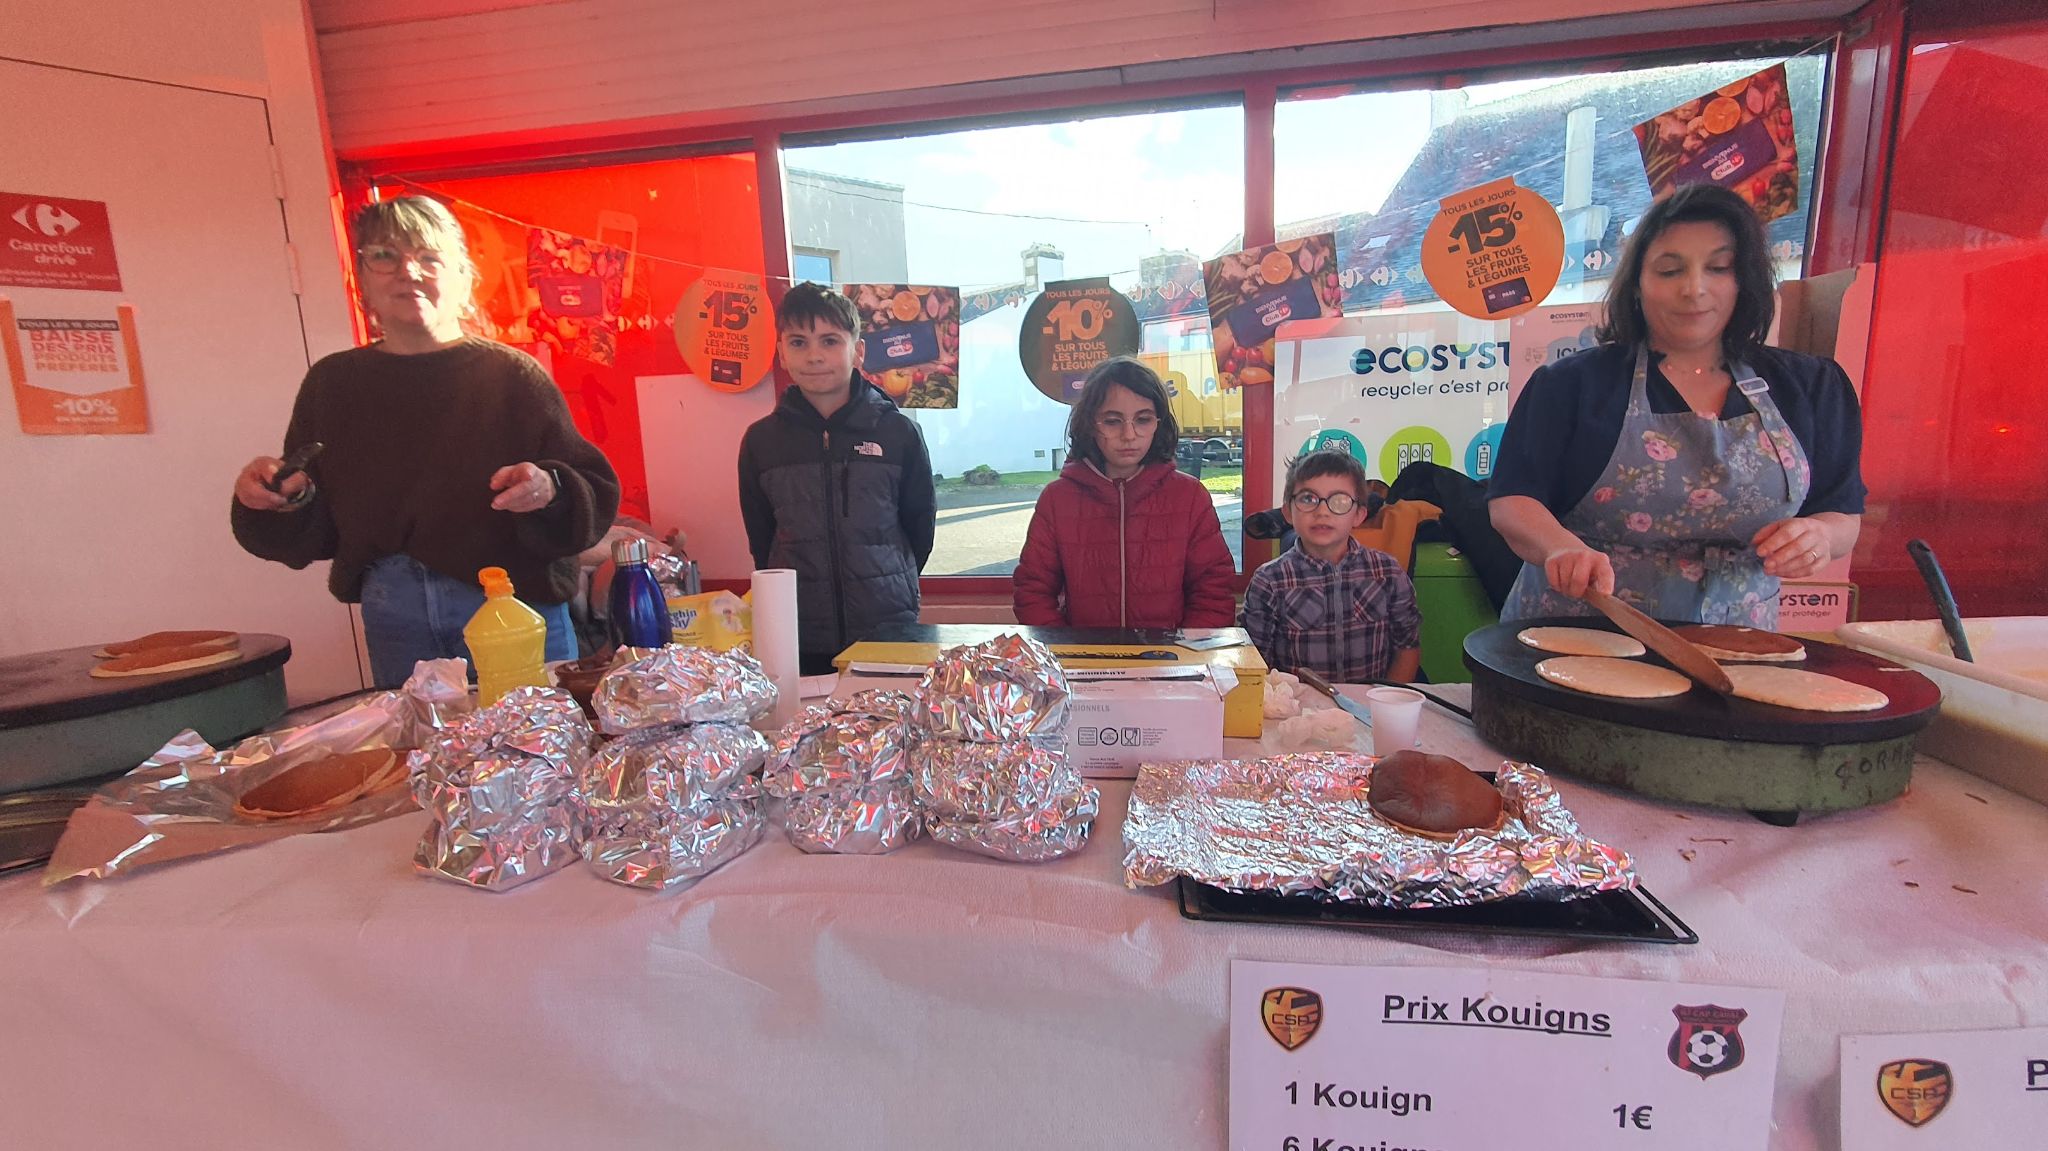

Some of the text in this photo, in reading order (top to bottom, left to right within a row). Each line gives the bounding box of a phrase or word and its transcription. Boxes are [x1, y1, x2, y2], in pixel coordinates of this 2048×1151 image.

[1443, 188, 1516, 216] TOUS LES JOURS
[1448, 201, 1523, 254] -15%
[8, 239, 96, 255] Carrefour
[34, 254, 77, 266] drive
[1466, 245, 1523, 268] SUR TOUS
[1466, 254, 1528, 278] LES FRUITS
[737, 283, 758, 292] JOURS
[1467, 279, 1475, 288] &
[1047, 291, 1066, 299] TOUS
[1069, 289, 1080, 297] LES
[699, 290, 757, 330] -15%
[1043, 299, 1113, 341] -10%
[30, 330, 113, 343] BAISSE
[708, 330, 749, 342] SUR TOUS
[32, 342, 115, 353] DES PRIX
[705, 339, 750, 352] LES FRUITS
[1055, 342, 1106, 352] SUR TOUS
[34, 352, 118, 362] PRODUITS
[1053, 351, 1109, 362] LES FRUITS
[1052, 363, 1058, 371] &
[1361, 382, 1433, 399] recycler
[1440, 379, 1480, 394] c'est
[53, 398, 117, 415] -10%
[1384, 995, 1611, 1034] Prix Kouigns
[1285, 1081, 1432, 1117] 1 Kouign
[1612, 1104, 1653, 1130] 1€
